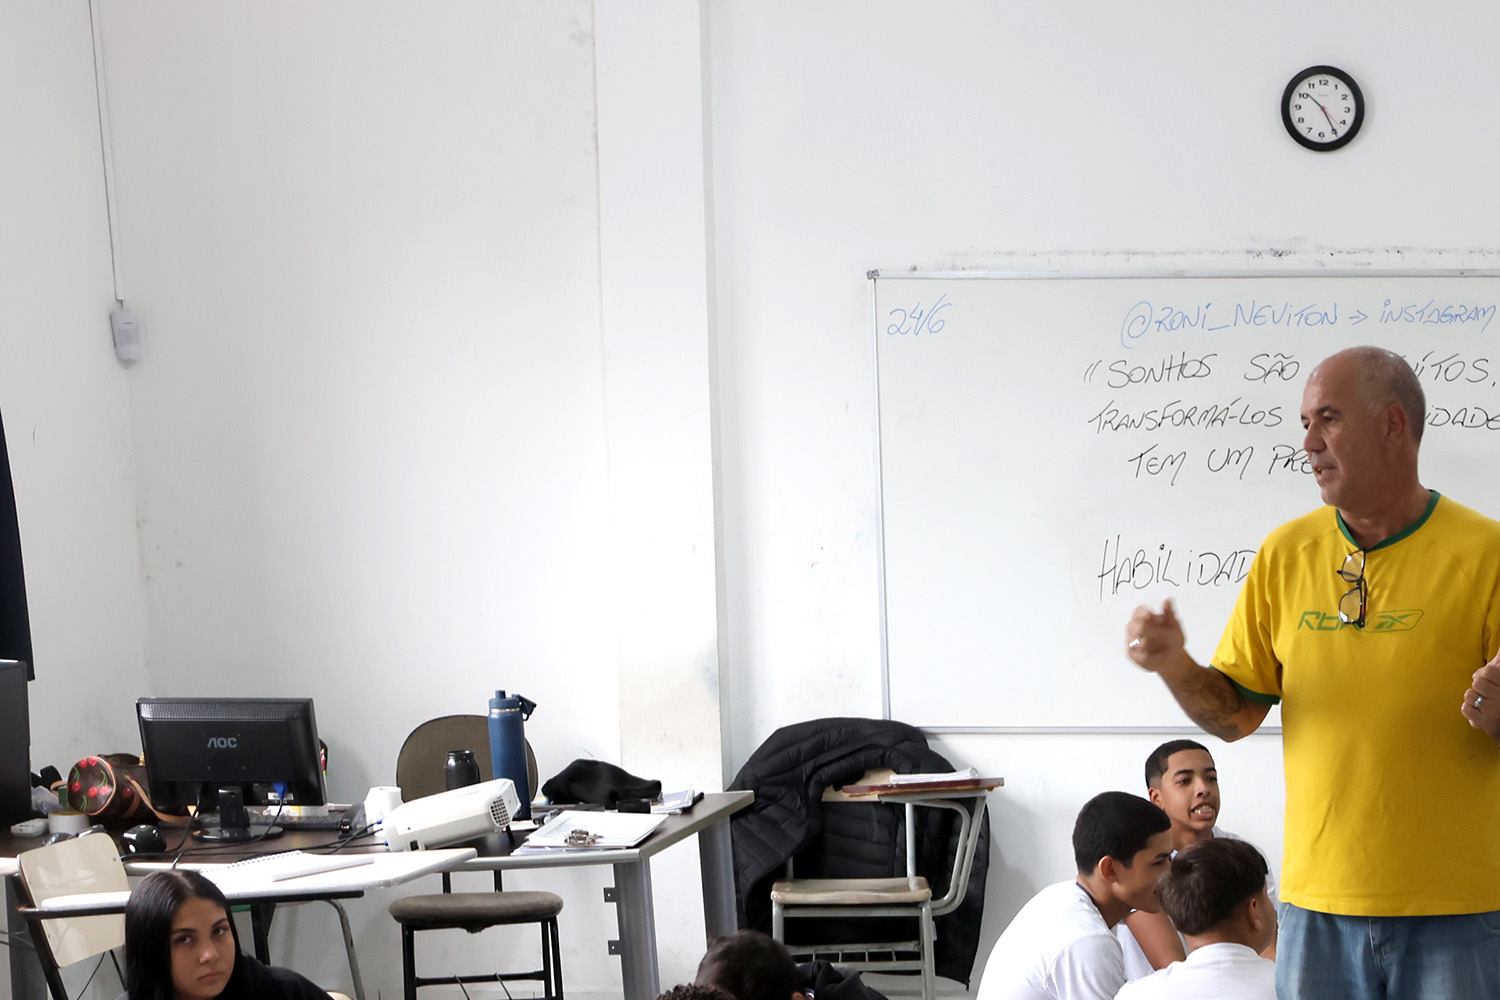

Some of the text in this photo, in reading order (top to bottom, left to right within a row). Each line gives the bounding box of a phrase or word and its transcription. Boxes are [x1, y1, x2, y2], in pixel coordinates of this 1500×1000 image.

[1244, 353, 1300, 382] SÃO
[1128, 444, 1315, 486] TEM UM PRE
[207, 737, 238, 748] AOC
